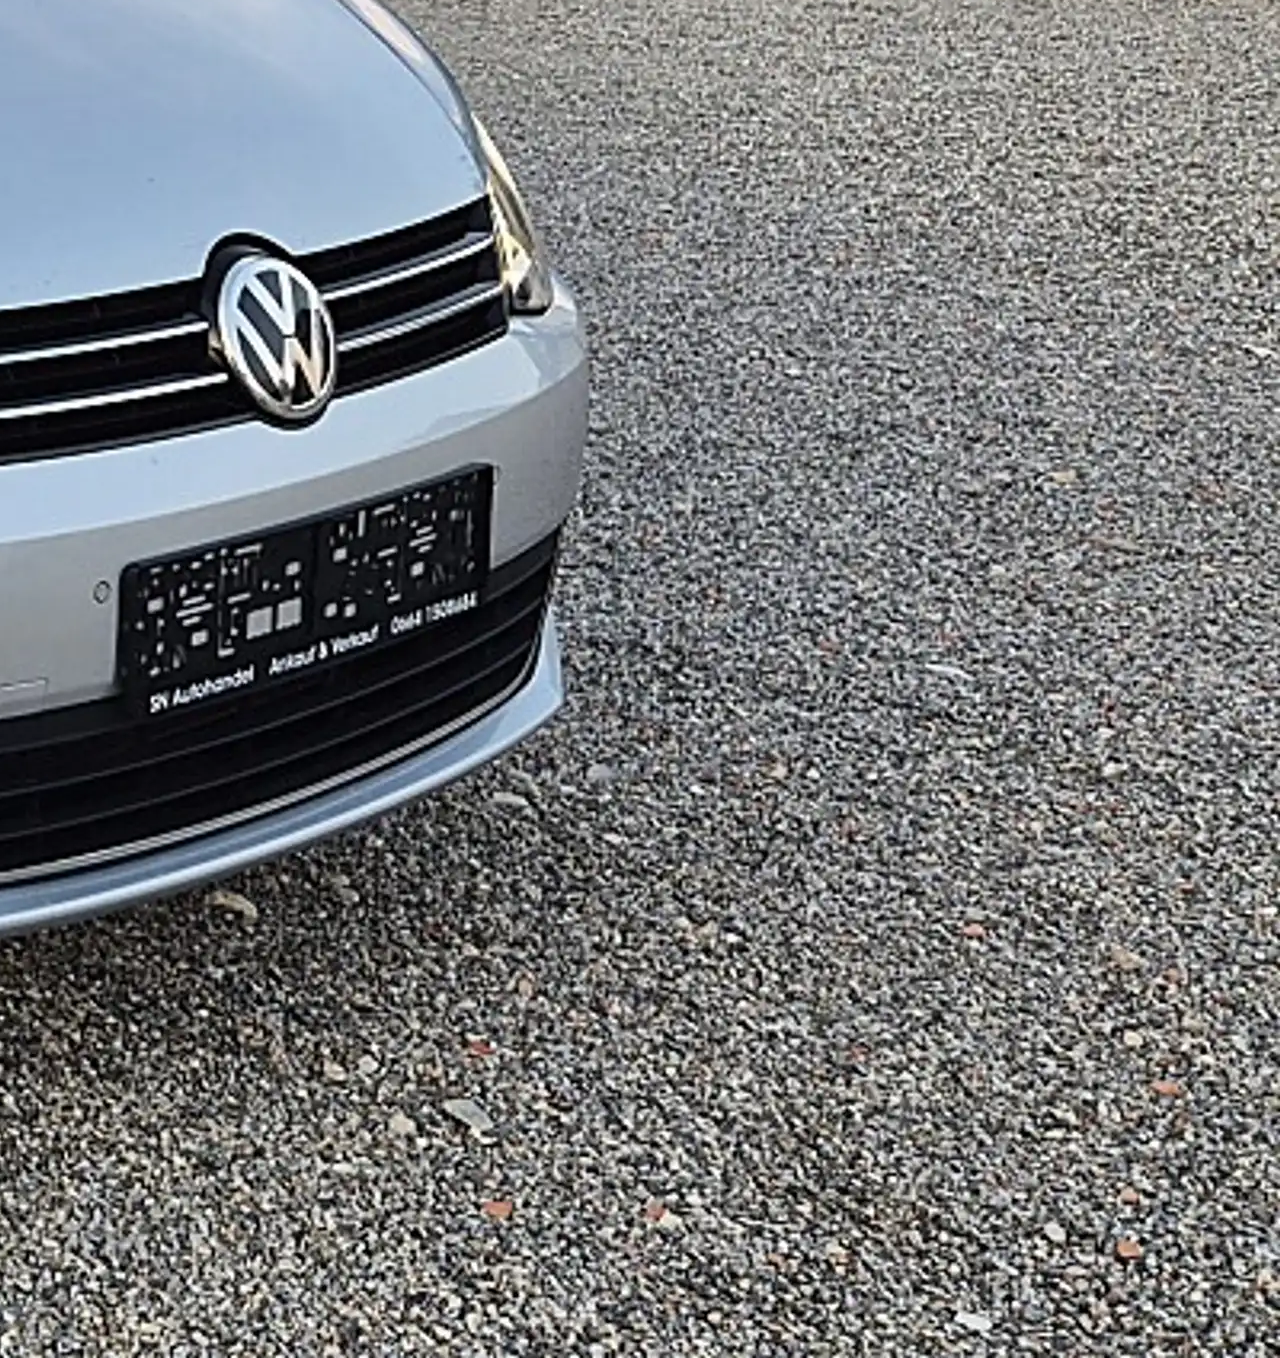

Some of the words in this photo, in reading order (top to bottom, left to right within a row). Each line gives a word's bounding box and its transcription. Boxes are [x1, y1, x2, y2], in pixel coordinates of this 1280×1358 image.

[172, 663, 255, 707] Autohandel
[268, 644, 317, 676] Ankauf
[318, 640, 329, 661] &
[329, 623, 380, 656] Verkauf
